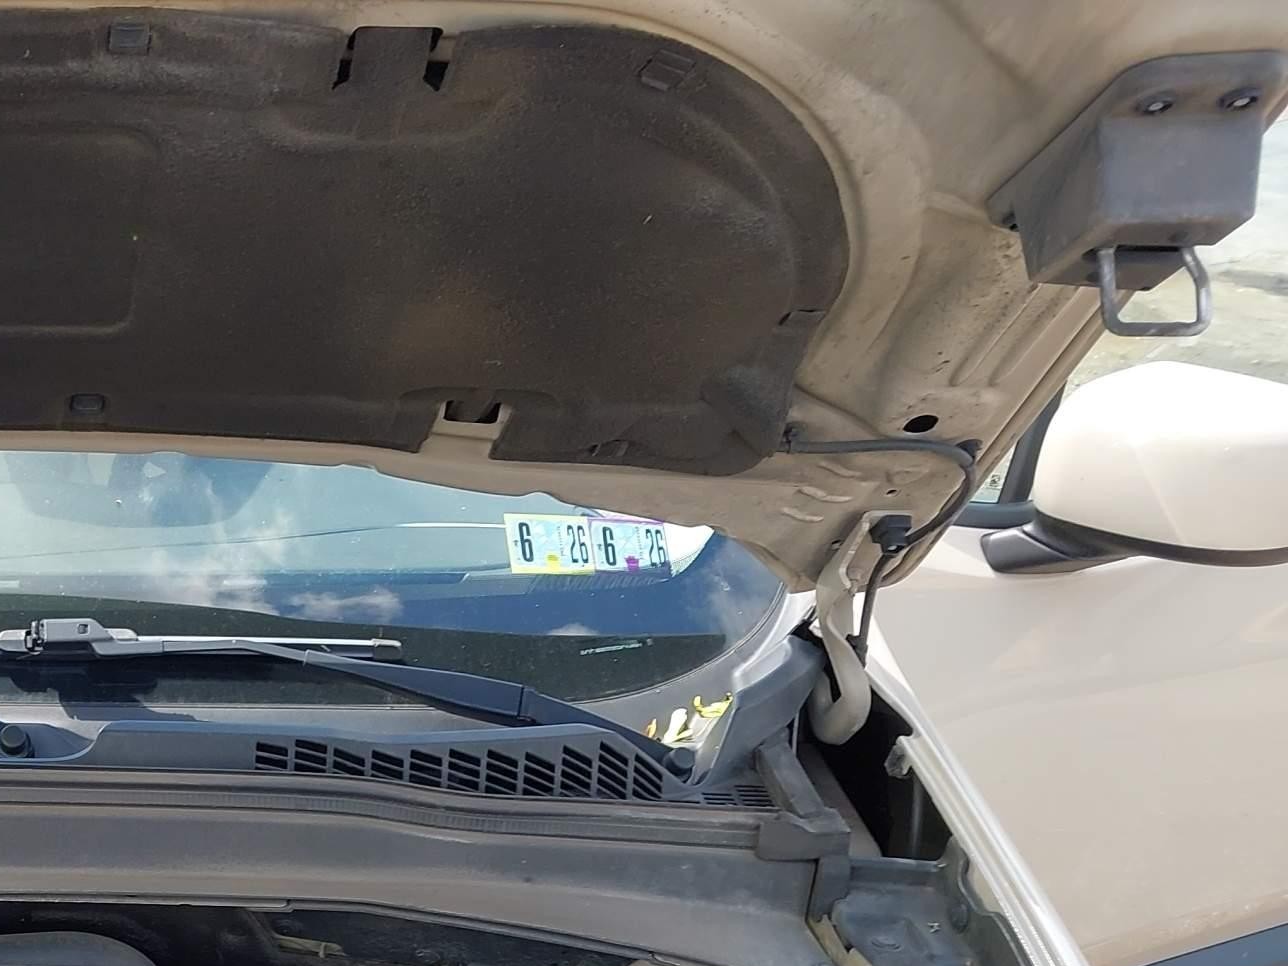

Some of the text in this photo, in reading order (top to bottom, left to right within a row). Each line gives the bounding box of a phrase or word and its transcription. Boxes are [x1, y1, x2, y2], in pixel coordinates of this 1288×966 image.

[518, 522, 534, 562] 6
[567, 525, 589, 563] 26
[602, 526, 617, 566] 6
[646, 528, 666, 567] 26
